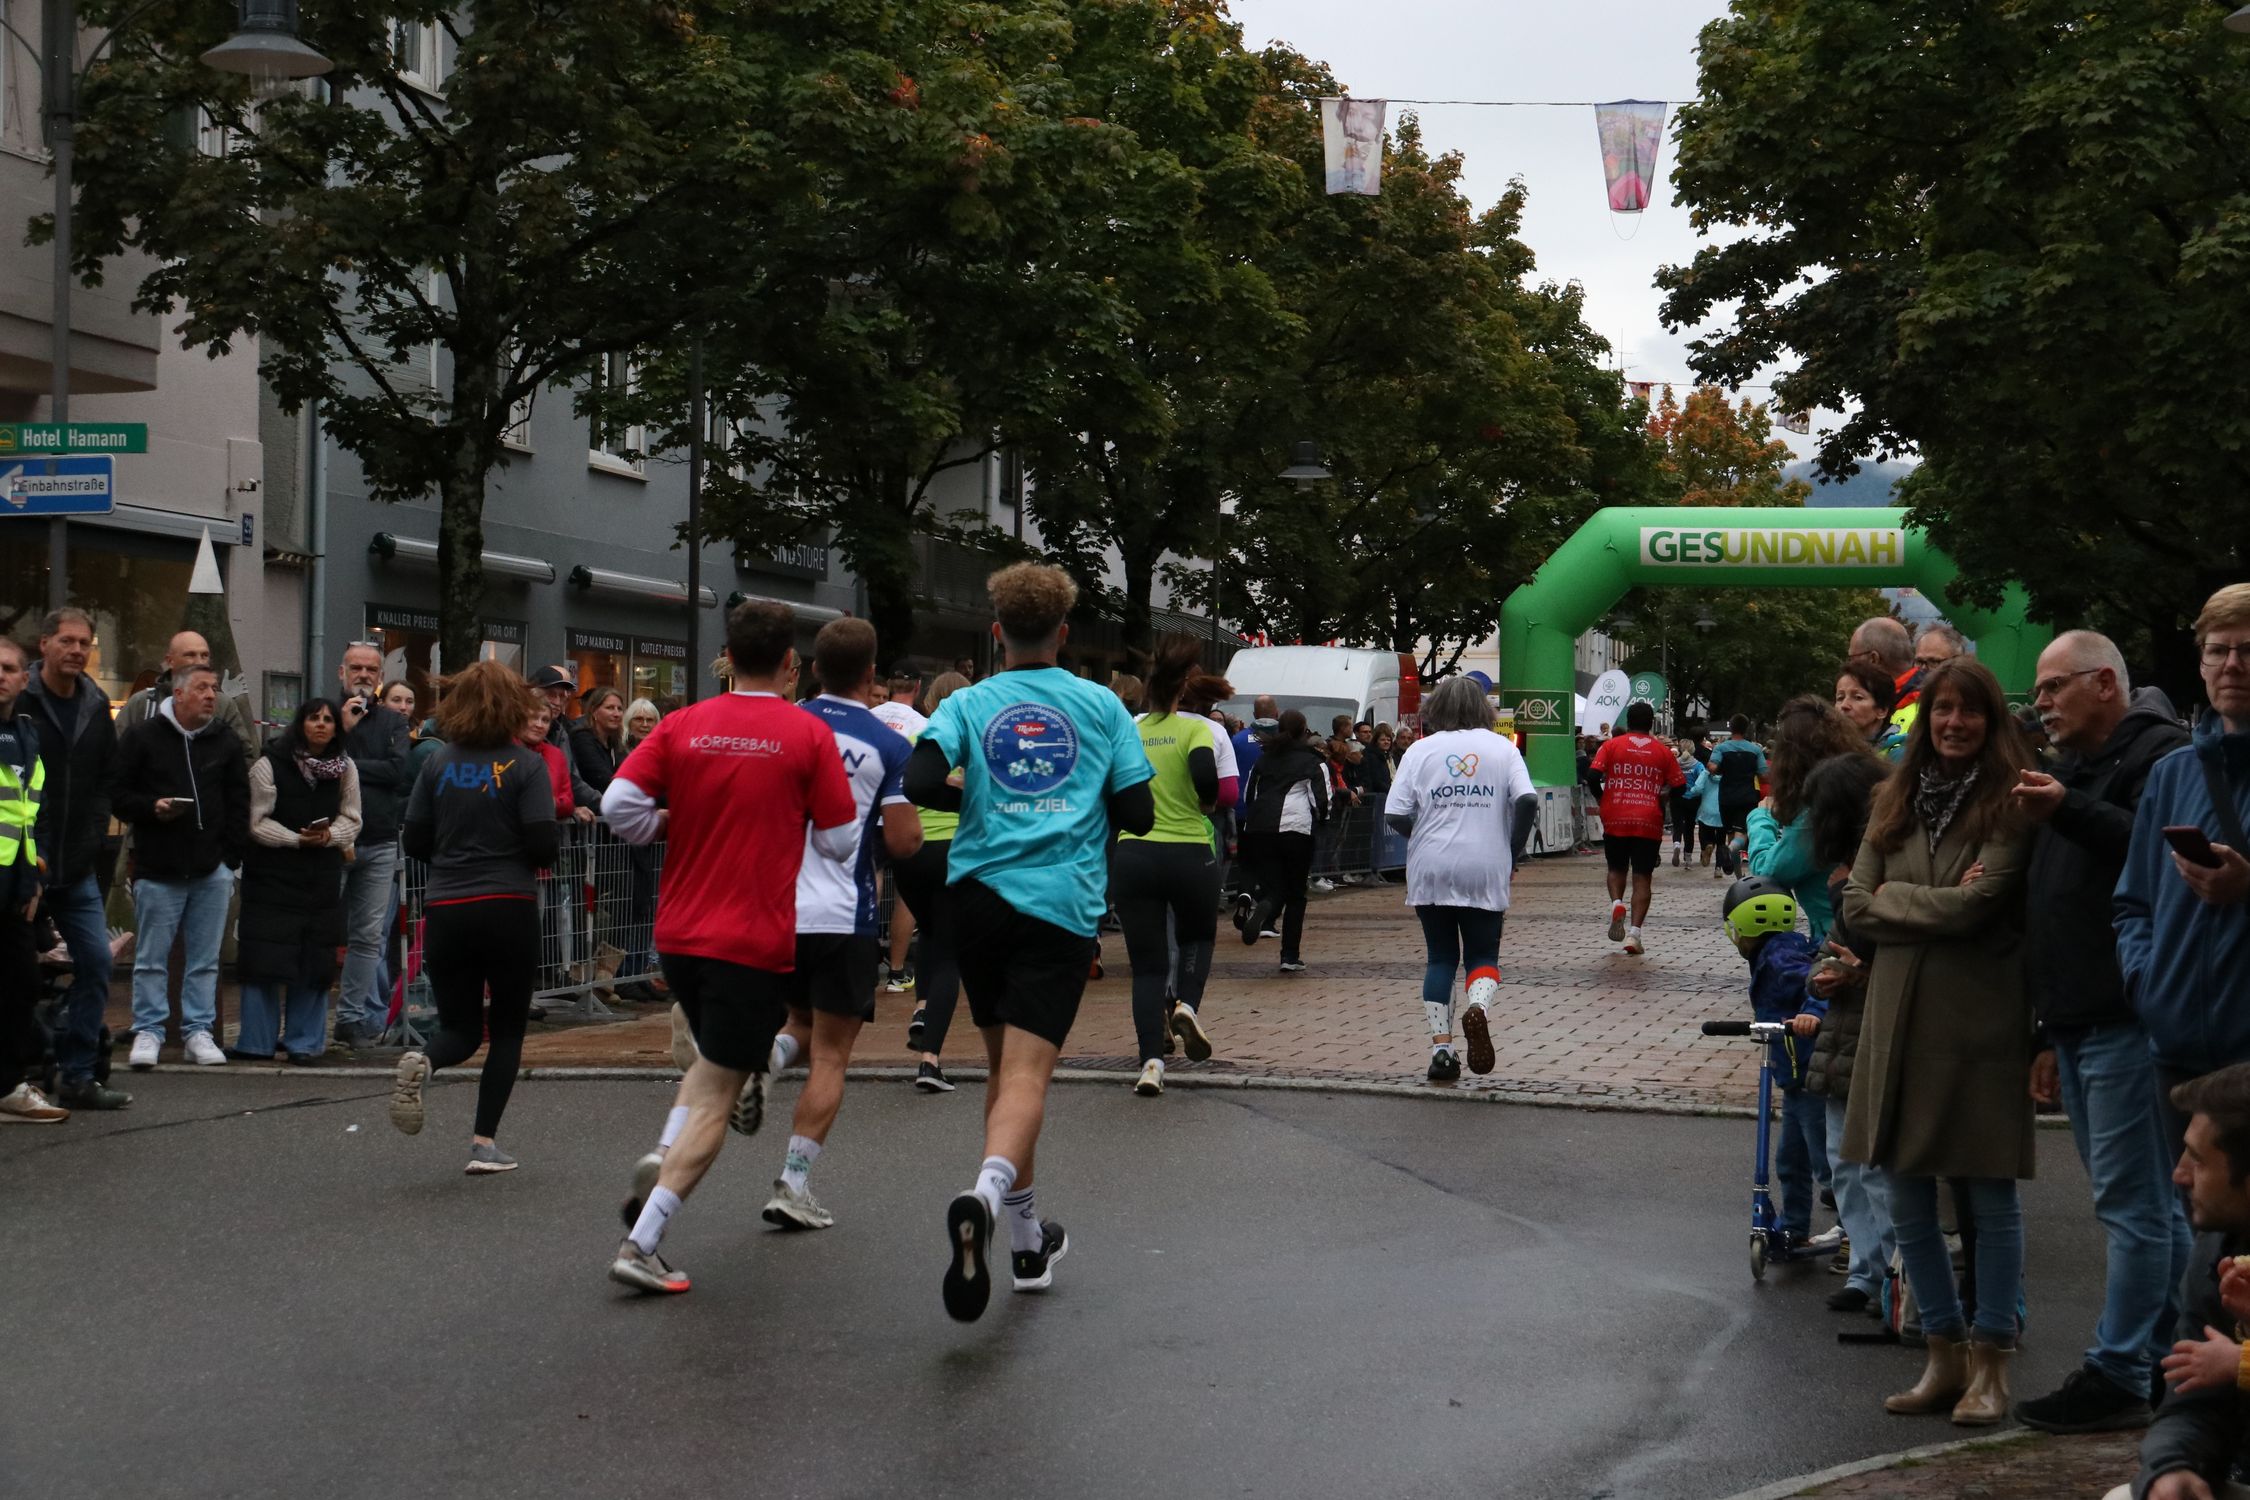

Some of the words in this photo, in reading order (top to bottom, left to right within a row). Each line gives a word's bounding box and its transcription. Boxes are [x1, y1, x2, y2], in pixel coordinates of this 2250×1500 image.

[23, 429, 61, 447] Hotel
[68, 428, 127, 447] Hamann
[1649, 531, 1896, 564] GESUNDNAH
[377, 610, 411, 627] KNALLER
[487, 624, 501, 637] VOR
[503, 626, 517, 639] ORT
[576, 634, 588, 647] TOP
[589, 636, 614, 650] MARKEN
[615, 639, 624, 651] ZU
[641, 642, 686, 658] OUTLET-PREISEN
[1513, 698, 1561, 720] AOK
[1595, 695, 1621, 706] AOK
[1613, 763, 1661, 780] ABOUT
[1431, 784, 1494, 800] KORIAN
[1608, 777, 1660, 794] PASSION
